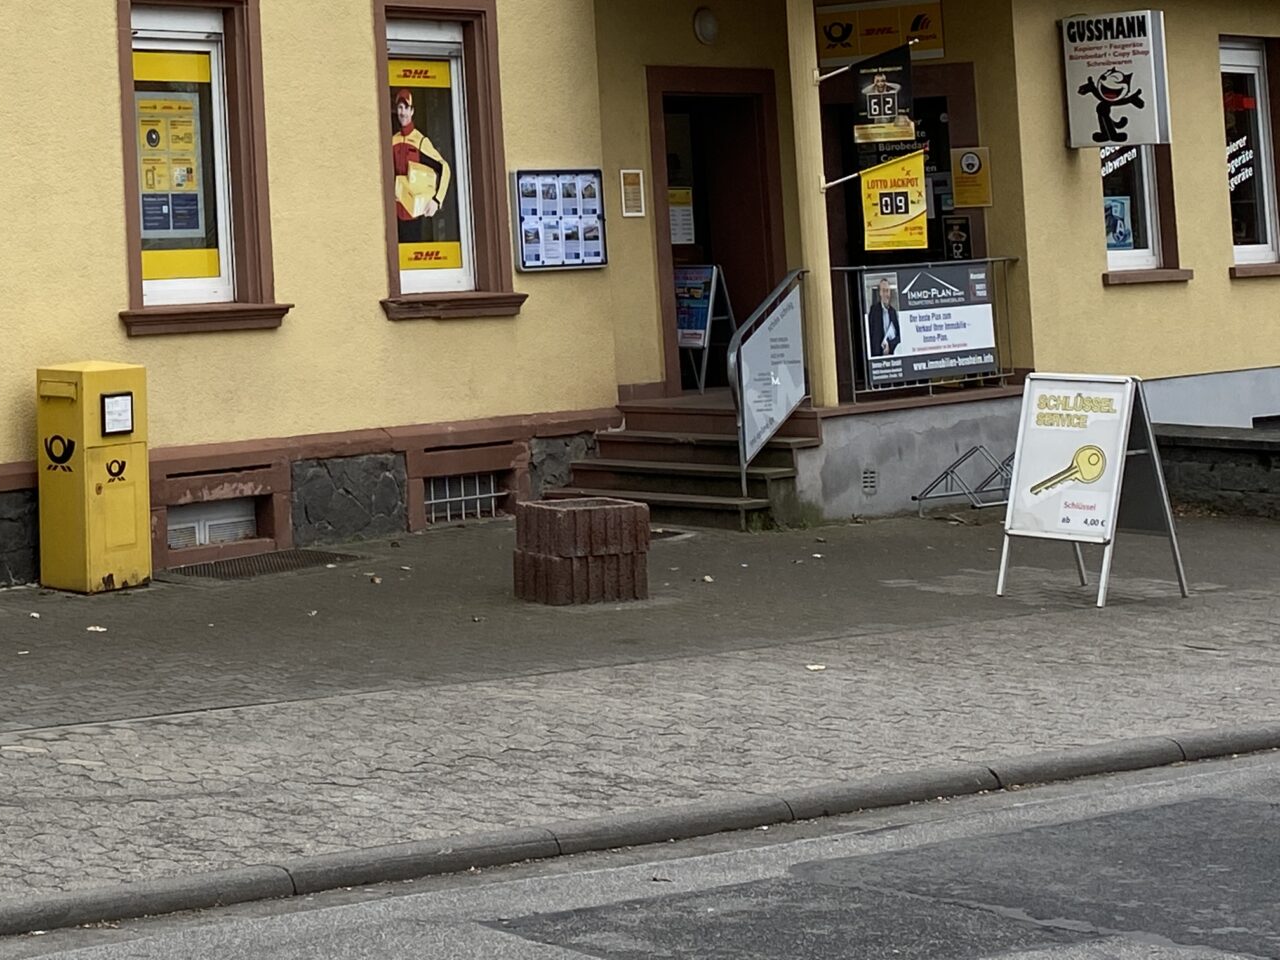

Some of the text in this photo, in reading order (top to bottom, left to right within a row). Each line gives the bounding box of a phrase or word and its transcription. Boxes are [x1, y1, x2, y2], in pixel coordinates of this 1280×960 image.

[1066, 15, 1147, 43] GUSSMANN
[1101, 147, 1137, 177] eibwaren
[867, 177, 919, 190] LOTTO JACKPOT
[931, 312, 942, 321] Plan
[1037, 393, 1117, 414] SCHLÜSSEL
[1035, 412, 1089, 429] SERVICE
[1063, 500, 1097, 511] Schlüssel
[1061, 516, 1071, 524] ab
[1083, 517, 1100, 527] 4,00
